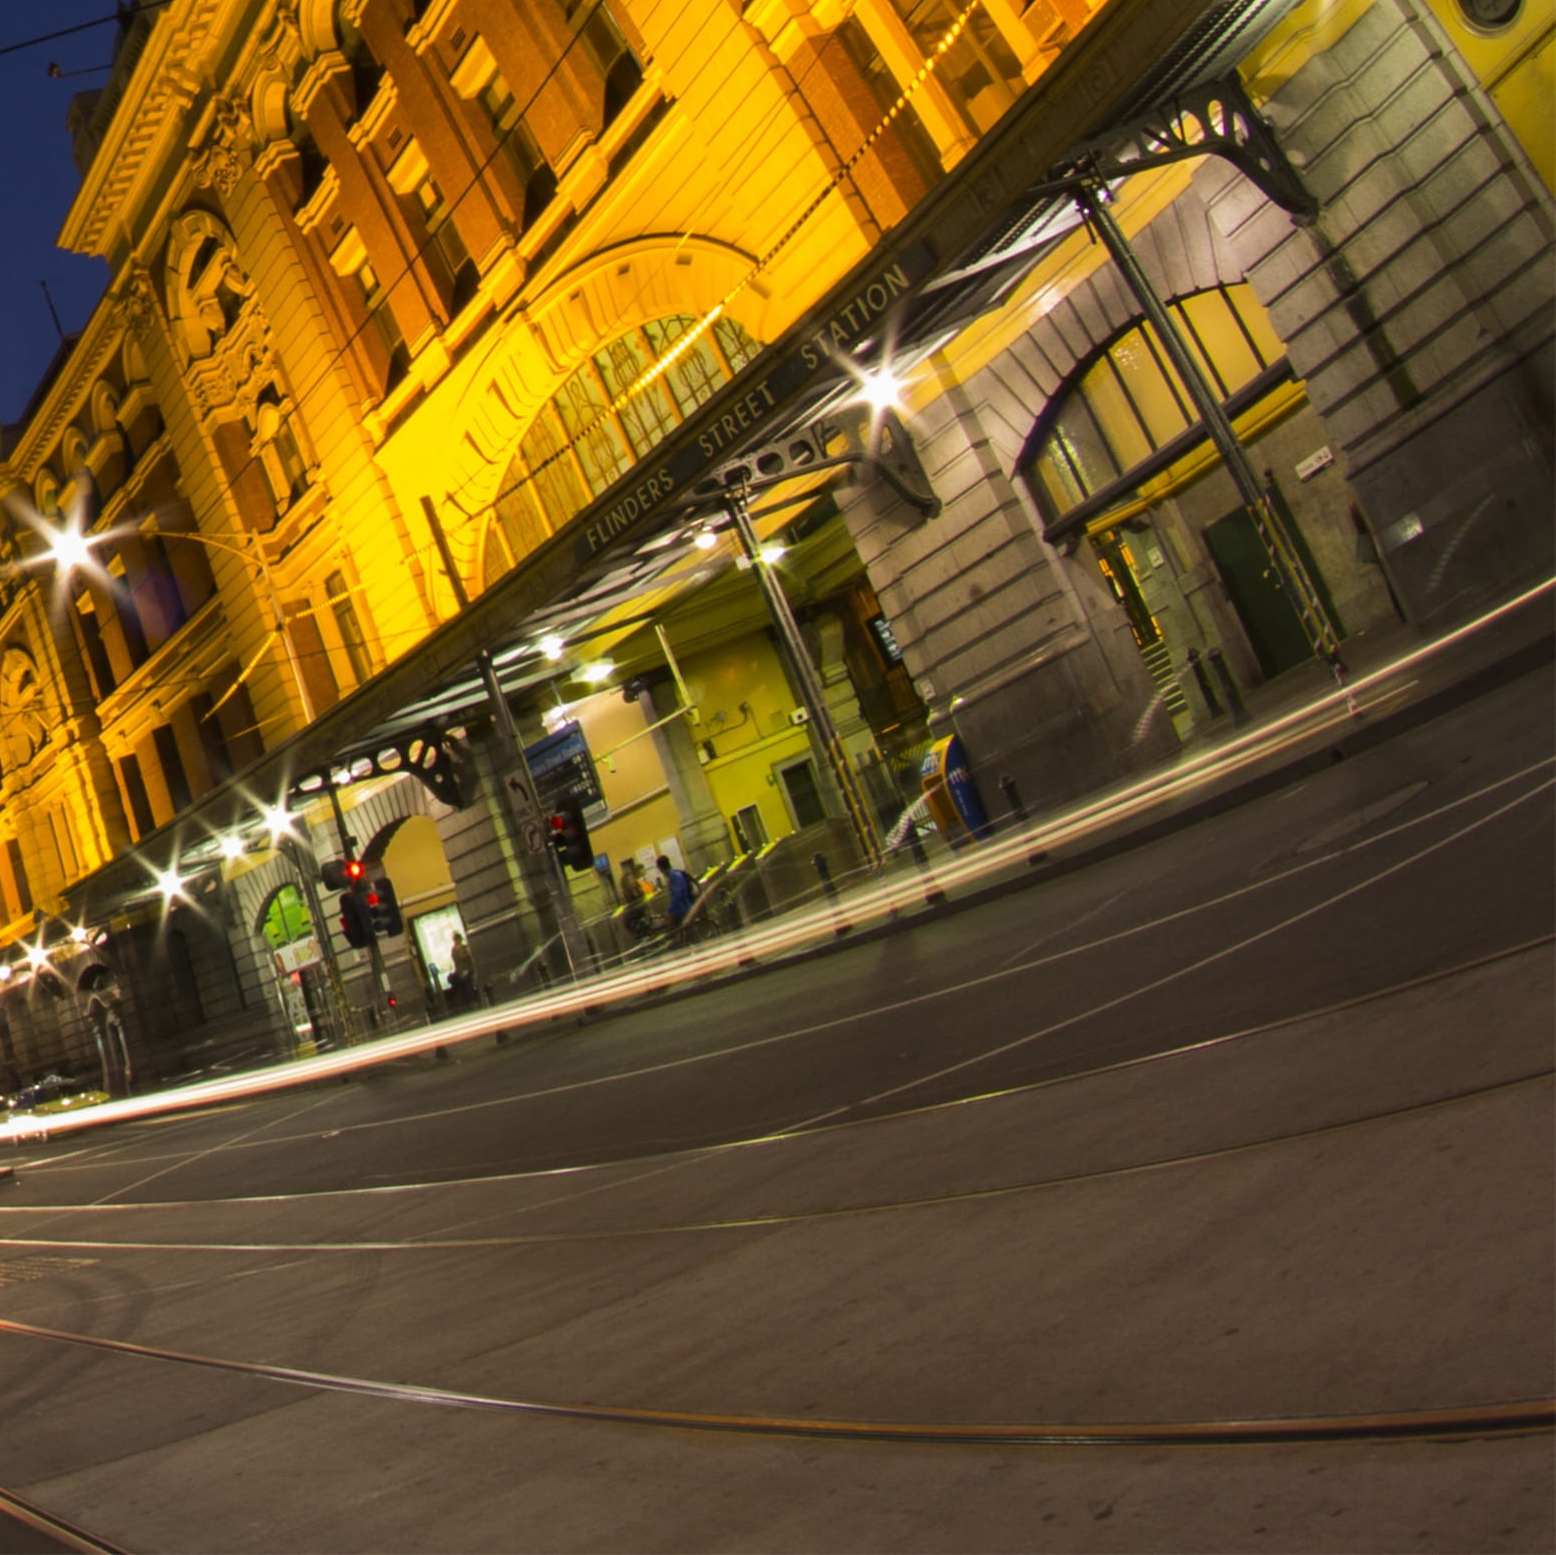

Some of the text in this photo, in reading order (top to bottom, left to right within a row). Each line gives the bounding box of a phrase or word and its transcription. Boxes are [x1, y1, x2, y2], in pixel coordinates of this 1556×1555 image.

[586, 263, 910, 552] FLINDERS STREET STATION
